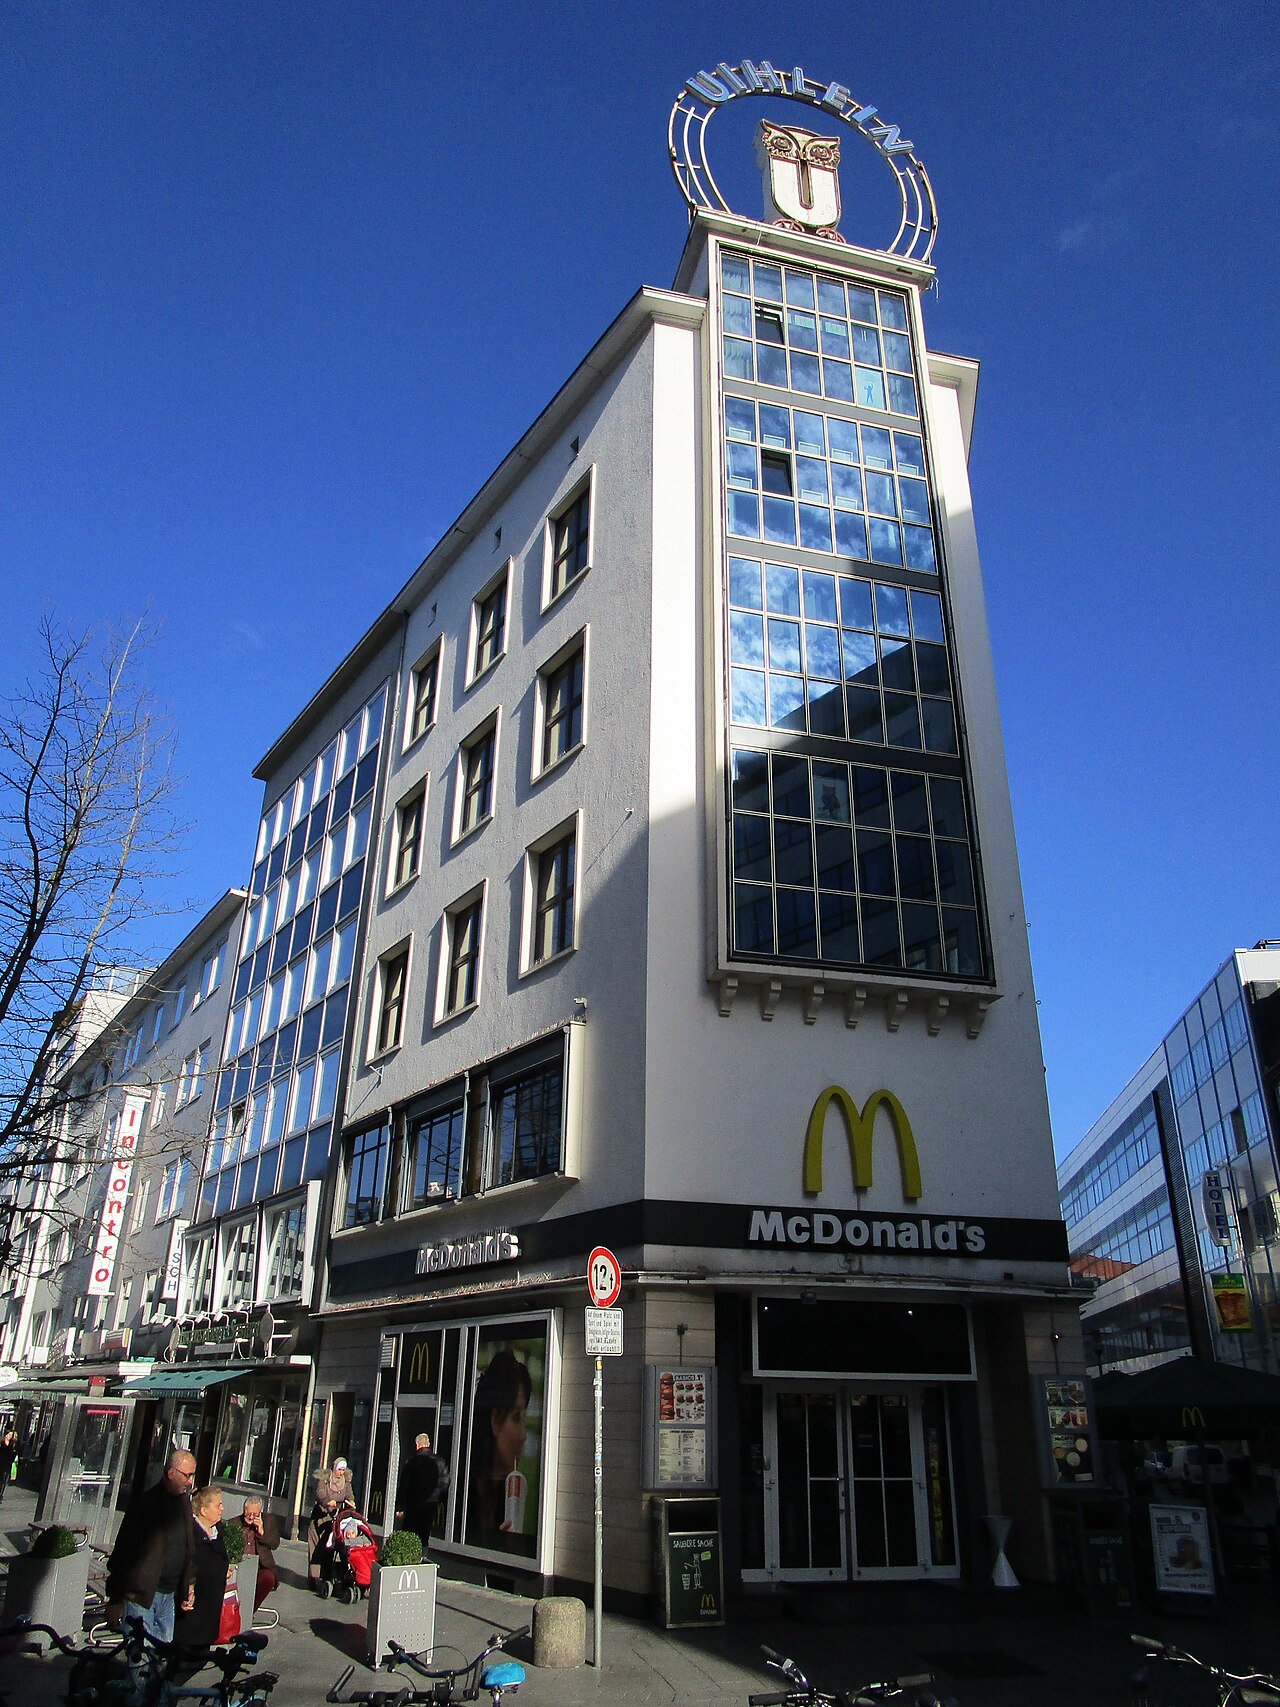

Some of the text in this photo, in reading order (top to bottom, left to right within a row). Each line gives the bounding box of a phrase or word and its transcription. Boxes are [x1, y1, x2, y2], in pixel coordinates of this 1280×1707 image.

[686, 60, 915, 157] UIHLEIN
[95, 1110, 135, 1282] Incontro
[1206, 1176, 1229, 1239] HOTEL
[749, 1209, 986, 1252] McDonald's
[594, 1264, 614, 1291] 12 t
